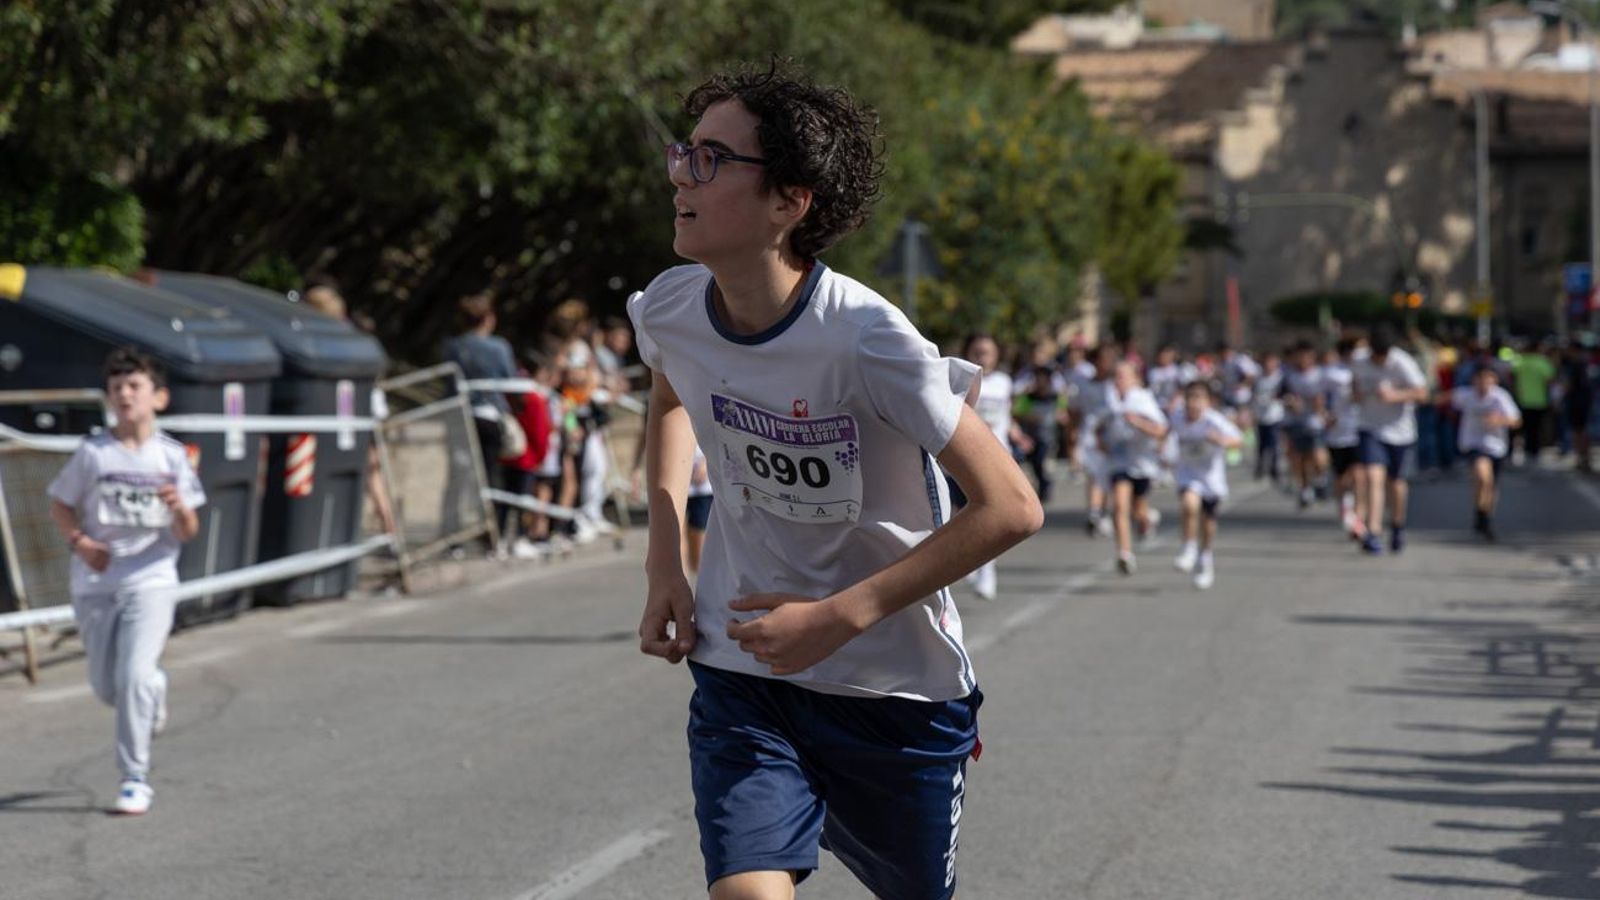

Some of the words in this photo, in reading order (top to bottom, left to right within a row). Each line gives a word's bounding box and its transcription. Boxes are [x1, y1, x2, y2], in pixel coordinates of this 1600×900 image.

[735, 405, 777, 439] XXXVI
[776, 420, 810, 434] CARRERA
[811, 419, 850, 433] ESCOLAR
[783, 431, 796, 442] LA
[802, 430, 841, 443] GLORIA
[746, 444, 830, 489] 690
